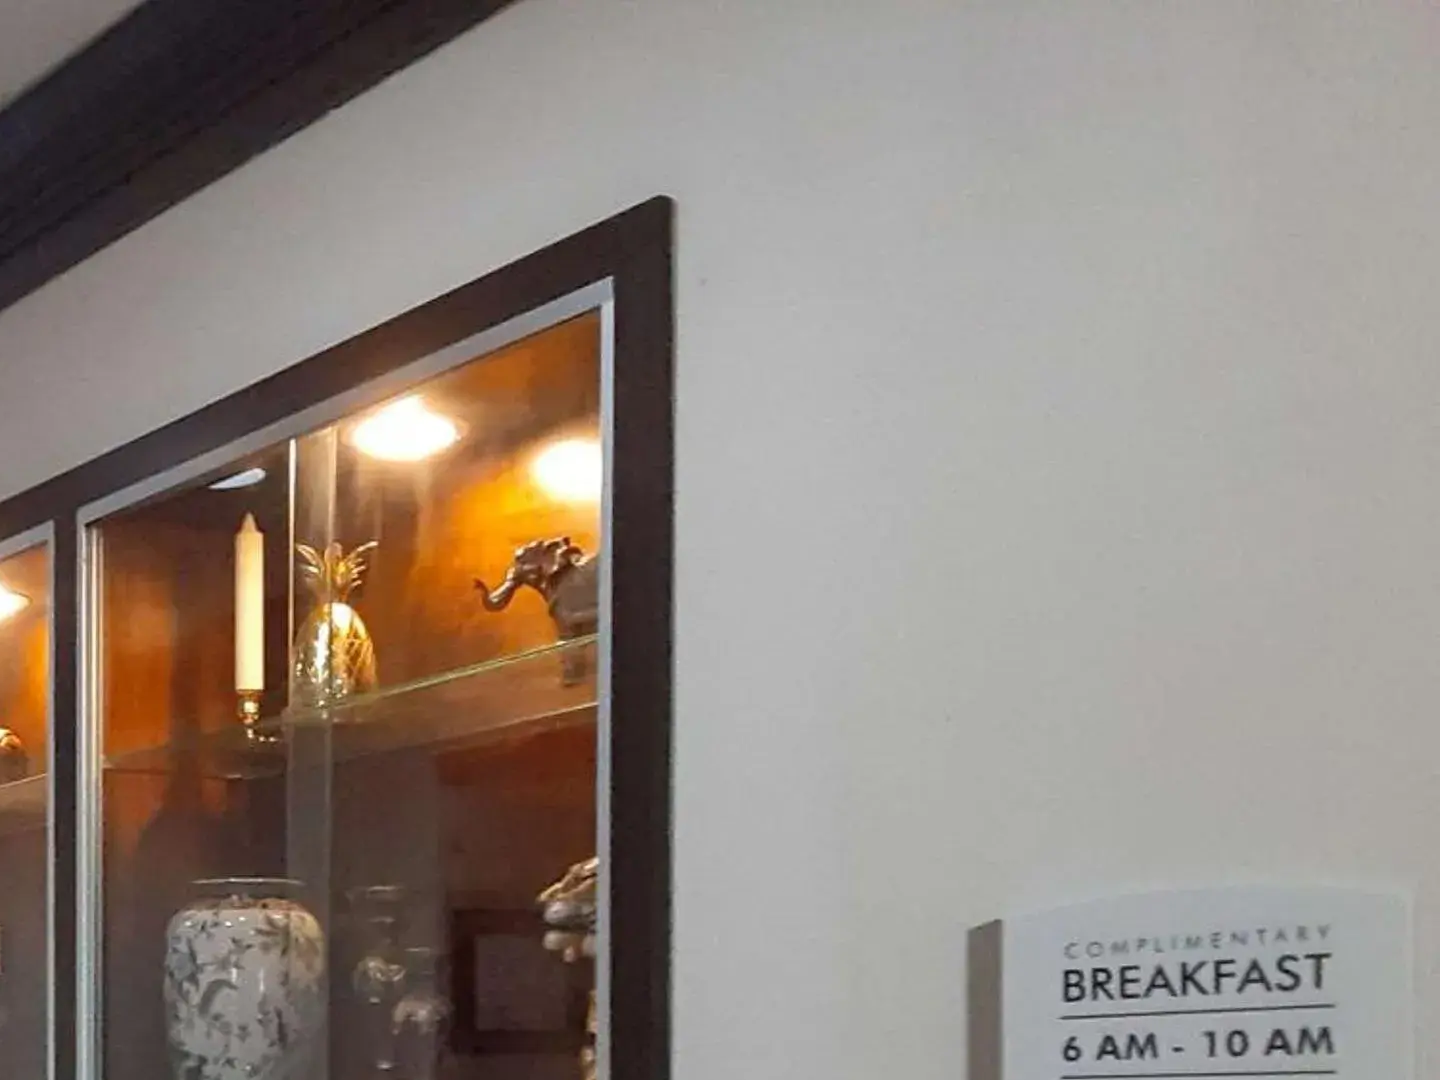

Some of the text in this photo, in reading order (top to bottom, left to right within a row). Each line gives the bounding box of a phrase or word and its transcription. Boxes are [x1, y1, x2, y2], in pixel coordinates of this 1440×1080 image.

[1063, 925, 1331, 960] COMPLIMENTARY
[1063, 952, 1332, 1003] BREAKFAST
[1063, 1036, 1082, 1062] 6
[1096, 1032, 1159, 1061] AM
[1203, 1029, 1250, 1058] 10
[1263, 1026, 1335, 1056] AM
